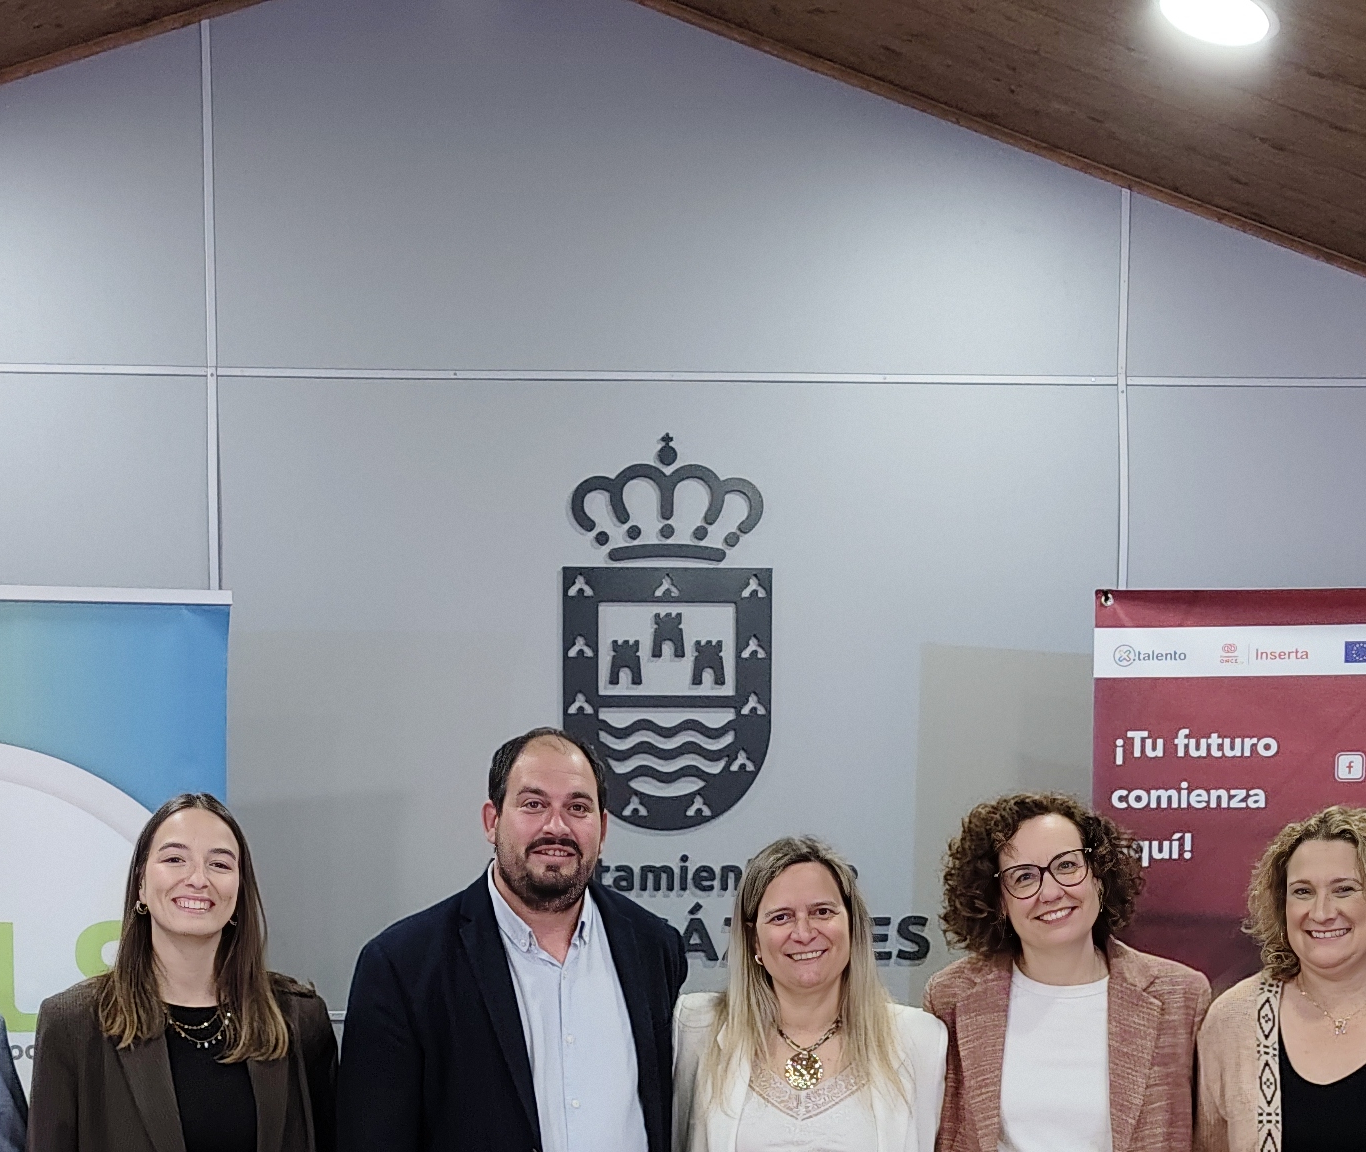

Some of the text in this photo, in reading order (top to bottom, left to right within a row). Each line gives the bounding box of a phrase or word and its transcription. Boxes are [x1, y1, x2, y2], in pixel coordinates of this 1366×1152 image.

[1255, 647, 1310, 661] Inserta
[1115, 728, 1278, 765] ¡Tu futuro
[1111, 781, 1266, 809] comienza
[1129, 832, 1192, 867] quí!
